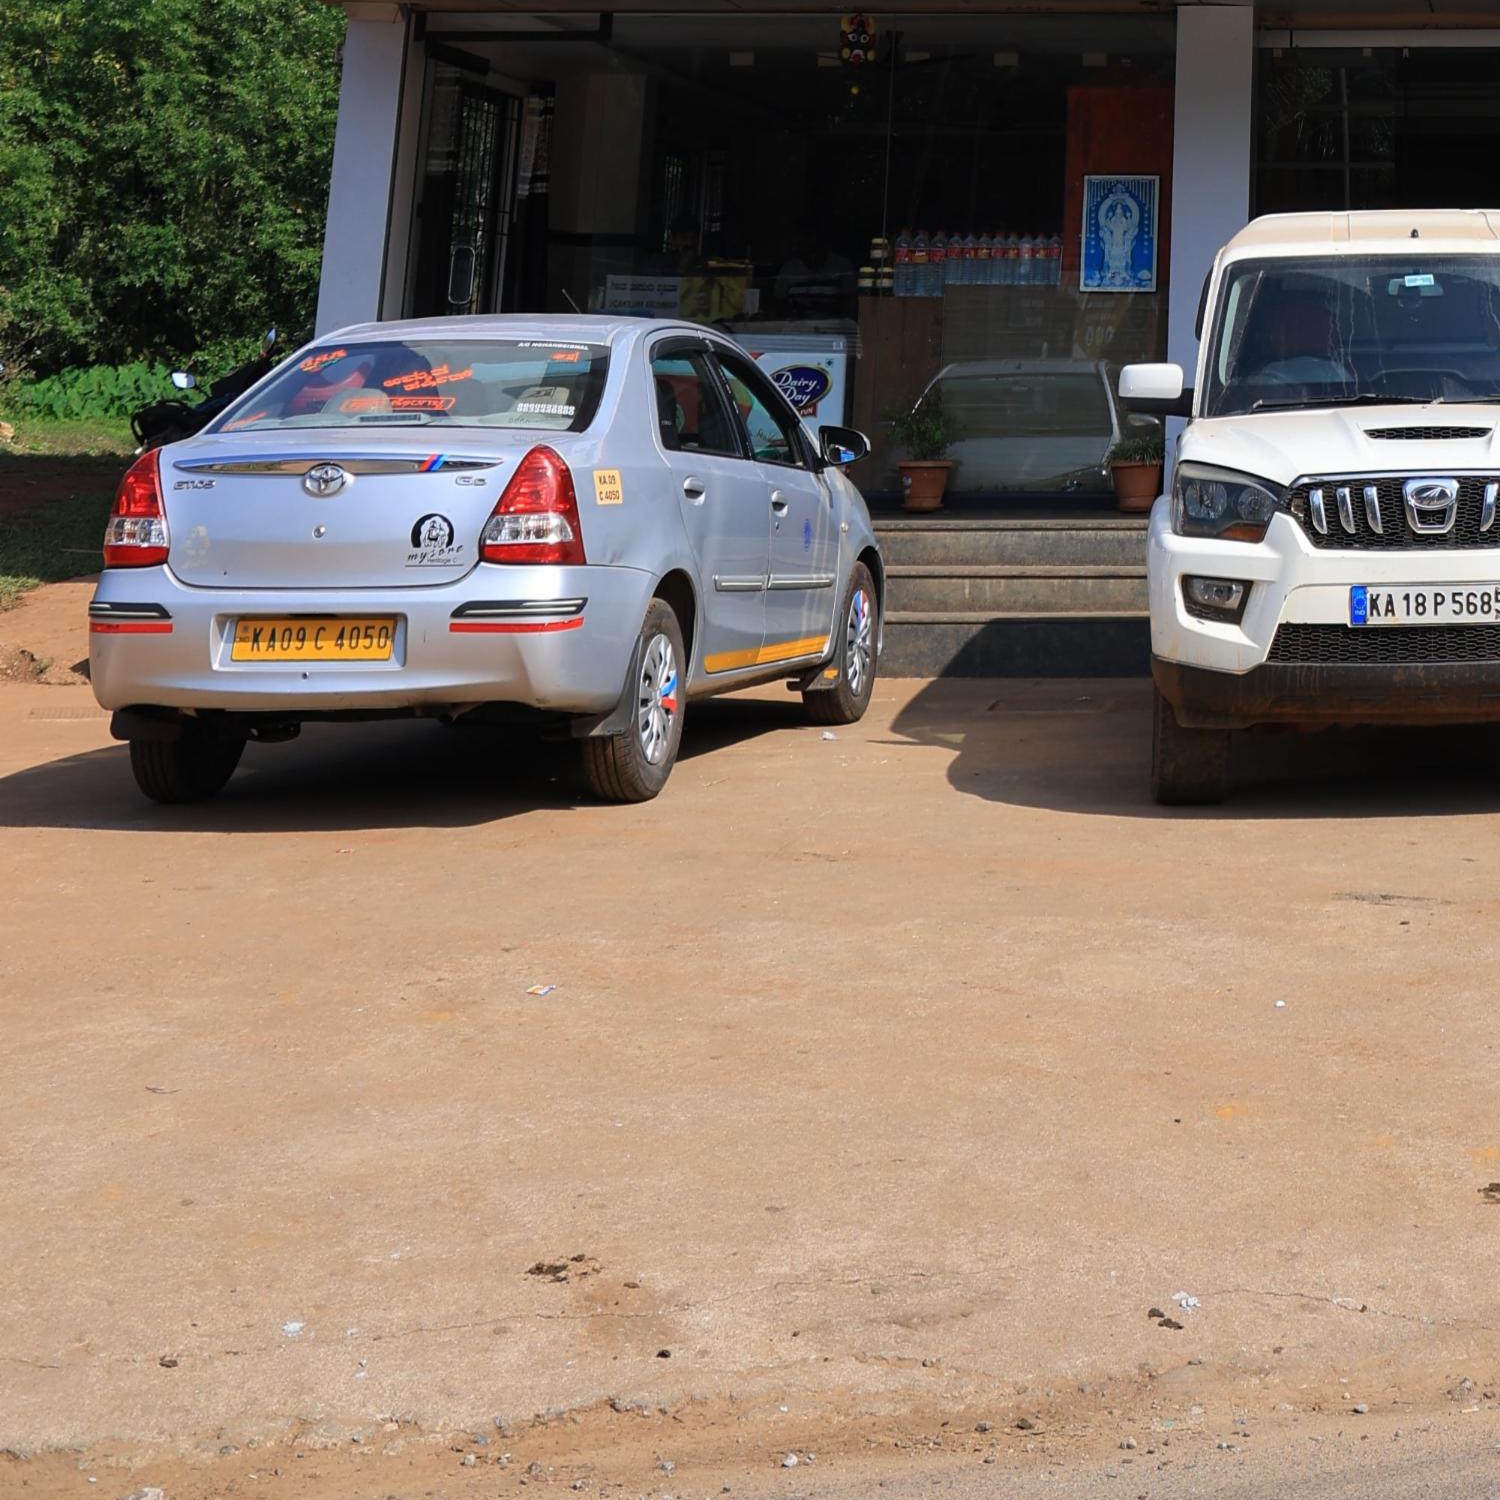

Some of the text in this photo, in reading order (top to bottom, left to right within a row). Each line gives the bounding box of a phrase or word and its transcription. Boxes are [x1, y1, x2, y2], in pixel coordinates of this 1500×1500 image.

[771, 371, 818, 392] Dairy
[780, 386, 811, 408] Day
[1369, 593, 1396, 617] KA
[1402, 592, 1427, 617] 18
[1433, 592, 1446, 616] P
[251, 625, 390, 652] KA09 C 4050
